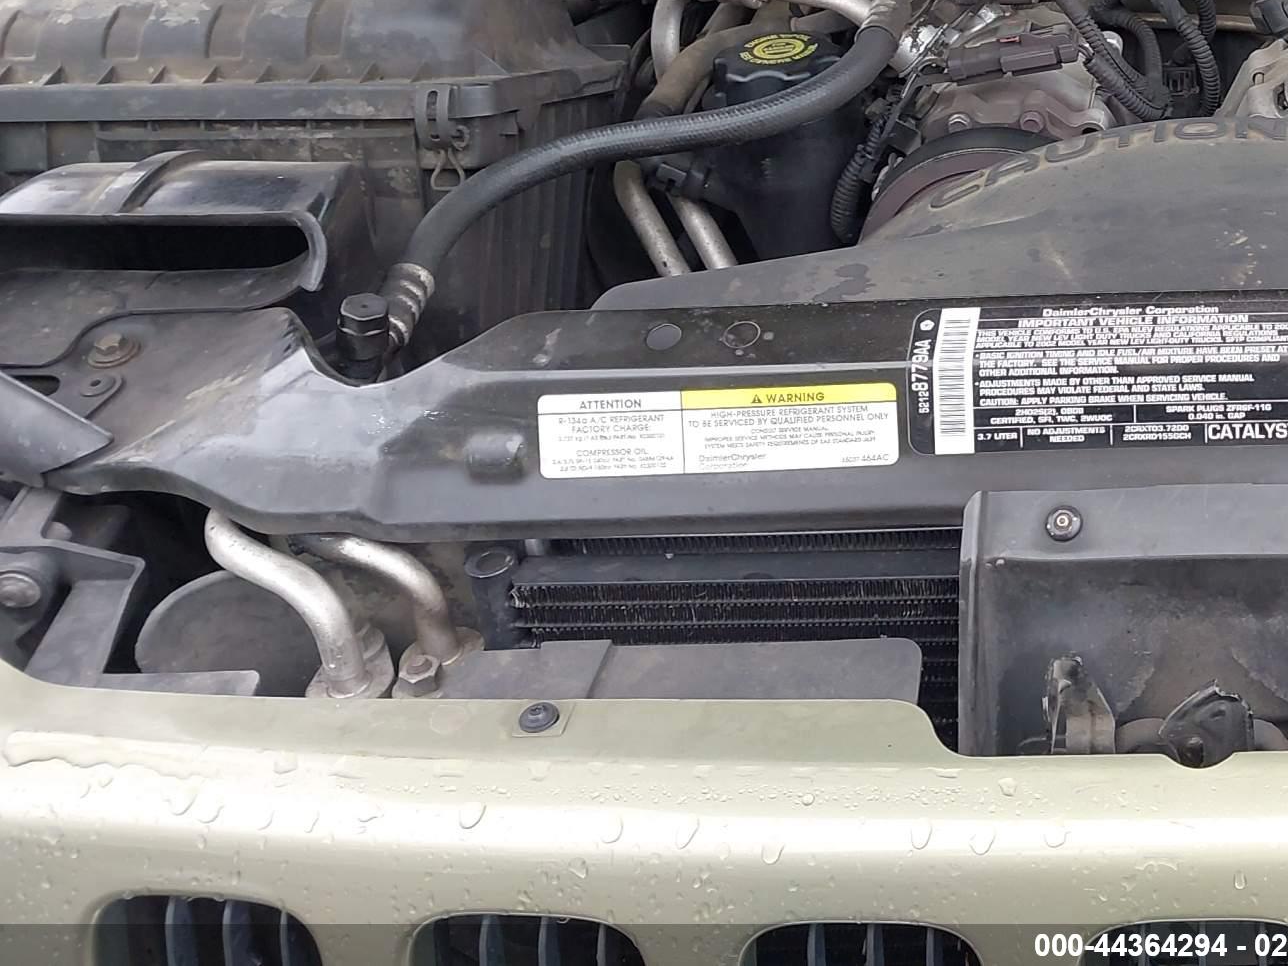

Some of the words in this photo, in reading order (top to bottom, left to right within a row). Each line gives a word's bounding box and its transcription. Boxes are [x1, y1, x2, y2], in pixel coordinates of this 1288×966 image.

[930, 118, 1287, 210] CAUTION
[1042, 306, 1142, 317] DaimlerChrysler
[1145, 305, 1219, 317] Corporation
[1018, 318, 1094, 328] IMPORTANT
[1098, 317, 1153, 326] VEHICLE
[1157, 315, 1248, 325] INFORMATION
[980, 351, 1006, 359] BASIC
[1006, 350, 1044, 359] IGNITION
[1044, 350, 1075, 358] TIMING
[1076, 349, 1096, 357] AND
[1096, 349, 1115, 357] IDLE
[1116, 348, 1156, 356] FUEL/AIR
[1196, 347, 1218, 355] HAVE
[1220, 346, 1243, 354] BEEN
[1244, 346, 1278, 354] PRESET
[1278, 345, 1288, 353] AT
[997, 359, 1037, 367] FACTORY.
[1059, 358, 1076, 366] THE
[1077, 357, 1113, 366] SERVICE
[1114, 357, 1150, 365] MANUAL
[1152, 356, 1169, 364] FOR
[1170, 356, 1203, 364] PROPER
[1204, 354, 1260, 363] PROCEDURES
[1261, 354, 1280, 362] AND
[978, 368, 1006, 376] OTHER
[1008, 367, 1058, 376] ADDITIONAL
[1059, 366, 1120, 375] INFORMATION.
[1042, 378, 1068, 386] MADE
[1068, 378, 1082, 386] BY
[1082, 377, 1111, 386] OTHER
[1112, 377, 1135, 385] THAN
[1136, 375, 1181, 384] APPROVED
[1181, 375, 1217, 383] SERVICE
[1218, 374, 1255, 382] MANUAL
[979, 387, 1035, 396] PROCEDURES
[1036, 387, 1056, 395] MAY
[1057, 386, 1091, 394] VIOLATE
[1092, 385, 1129, 394] FEDERAL
[1131, 384, 1150, 393] AND
[1151, 384, 1177, 392] STATE
[1178, 383, 1205, 392] LAWS.
[766, 392, 825, 403] WARNING
[979, 398, 1019, 406] CAUTION:
[1020, 397, 1048, 405] APPLY
[1049, 396, 1086, 405] PARKING
[1088, 395, 1116, 404] BRAKE
[1117, 395, 1144, 403] WHEN
[1146, 394, 1190, 402] SERVICING
[1192, 393, 1228, 401] VEHICLE.
[579, 399, 642, 409] ATTENTION
[1166, 405, 1195, 413] SPARK
[1196, 404, 1224, 412] PLUGS
[711, 409, 775, 418] HIGH-PRESSURE
[779, 406, 835, 416] REFRIGERANT
[837, 405, 868, 413] SYSTEM
[1188, 412, 1214, 420] 0.040
[1215, 412, 1226, 420] in.
[609, 414, 665, 423] REFRIGERANT
[688, 420, 699, 428] TO
[714, 418, 754, 427] SERVICED
[770, 416, 813, 425] QUALIFIED
[816, 414, 865, 423] PERSONNEL
[867, 413, 889, 421] ONLY
[571, 425, 610, 434] FACTORY
[614, 424, 649, 432] CHARGE
[1027, 428, 1041, 436] NO
[1042, 426, 1105, 435] ADJUSTMENTS
[976, 433, 992, 441] 3.7
[994, 432, 1018, 441] LITER
[576, 448, 632, 457] COMPRESSOR
